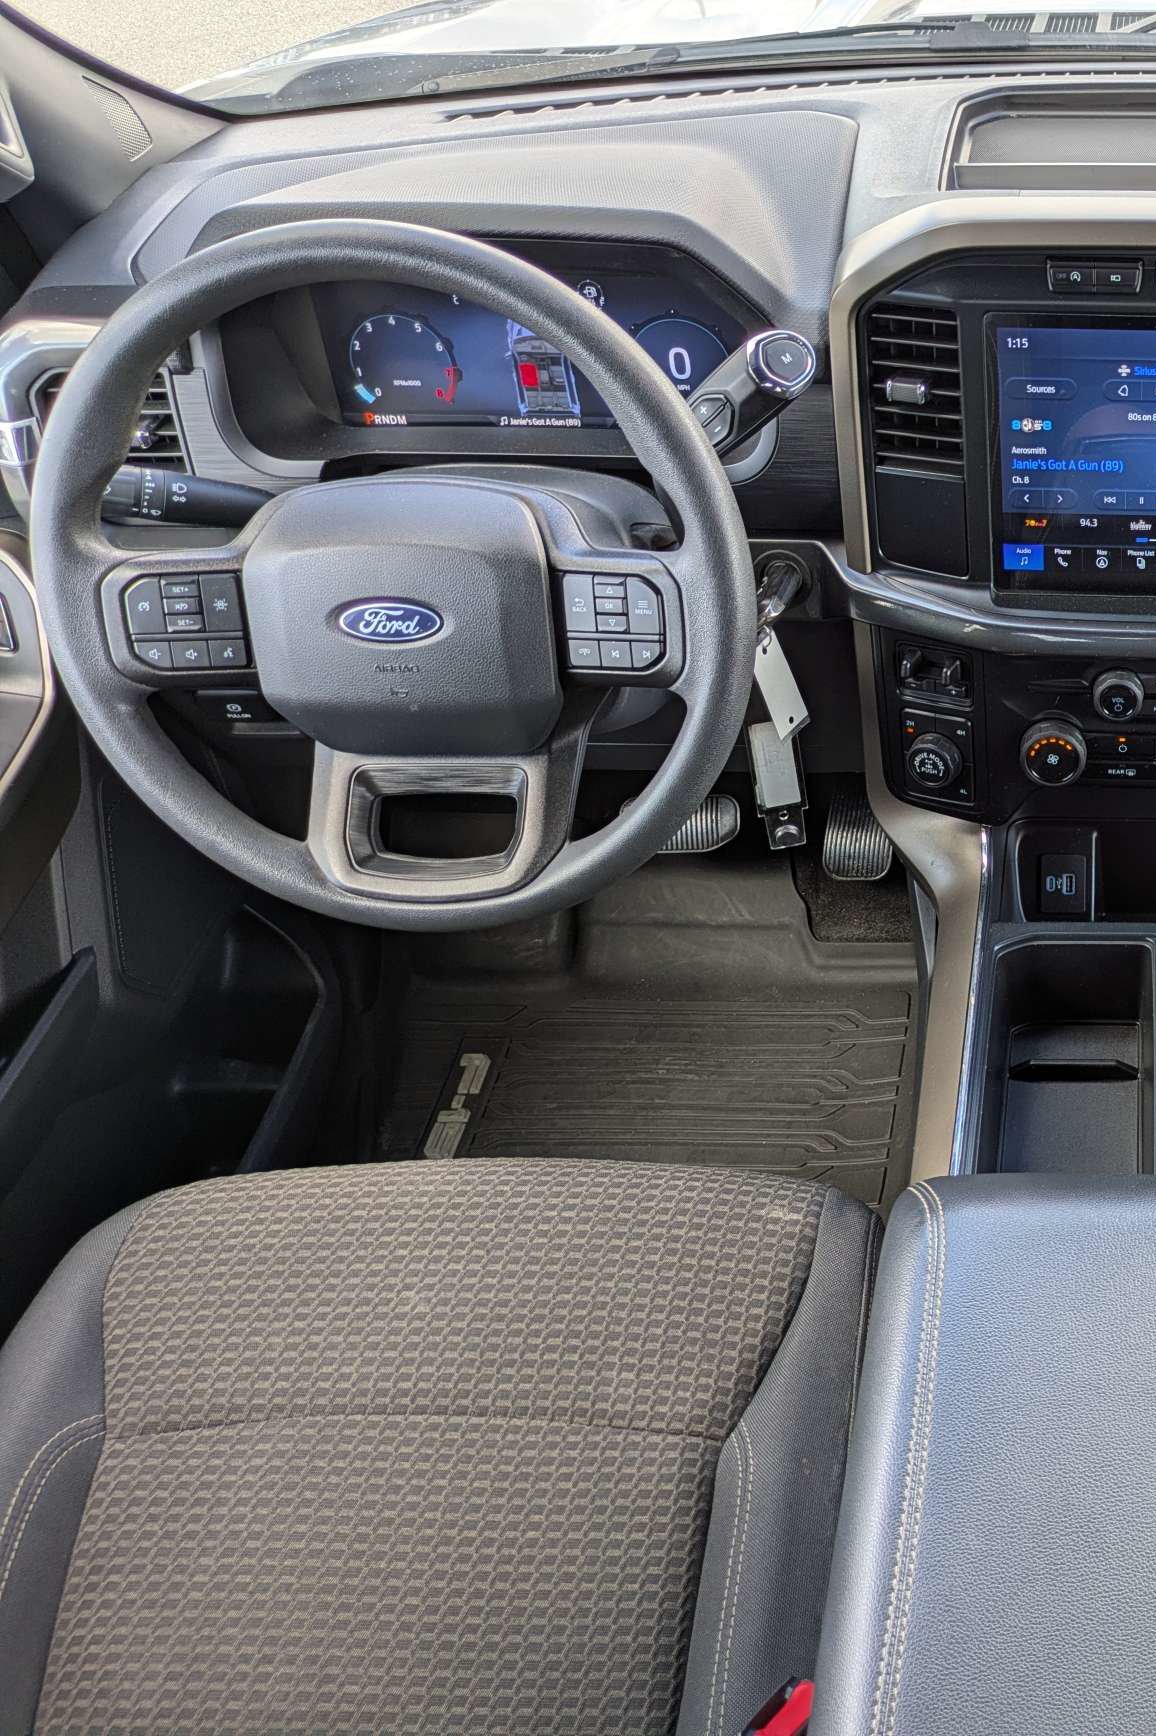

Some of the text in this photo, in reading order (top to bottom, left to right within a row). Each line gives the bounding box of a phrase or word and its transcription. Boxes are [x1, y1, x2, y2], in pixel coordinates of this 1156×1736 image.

[388, 316, 396, 325] 4
[366, 322, 372, 332] 3
[414, 322, 422, 332] 5
[354, 341, 360, 351] 2
[436, 342, 442, 352] 6
[1007, 338, 1028, 348] 1:15
[668, 347, 691, 380] 0
[781, 354, 792, 364] M
[356, 368, 362, 376] 1
[374, 388, 382, 396] 0
[1026, 384, 1056, 394] Sources
[1128, 412, 1142, 421] 80s
[1012, 446, 1047, 454] Aerosmith
[1012, 459, 1124, 472] Janie's Got A Gun (89)
[1012, 476, 1023, 484] Ch.
[1080, 518, 1098, 528] 94.3
[360, 608, 420, 634] Ford
[929, 753, 944, 770] MODE
[922, 766, 938, 774] PUSH
